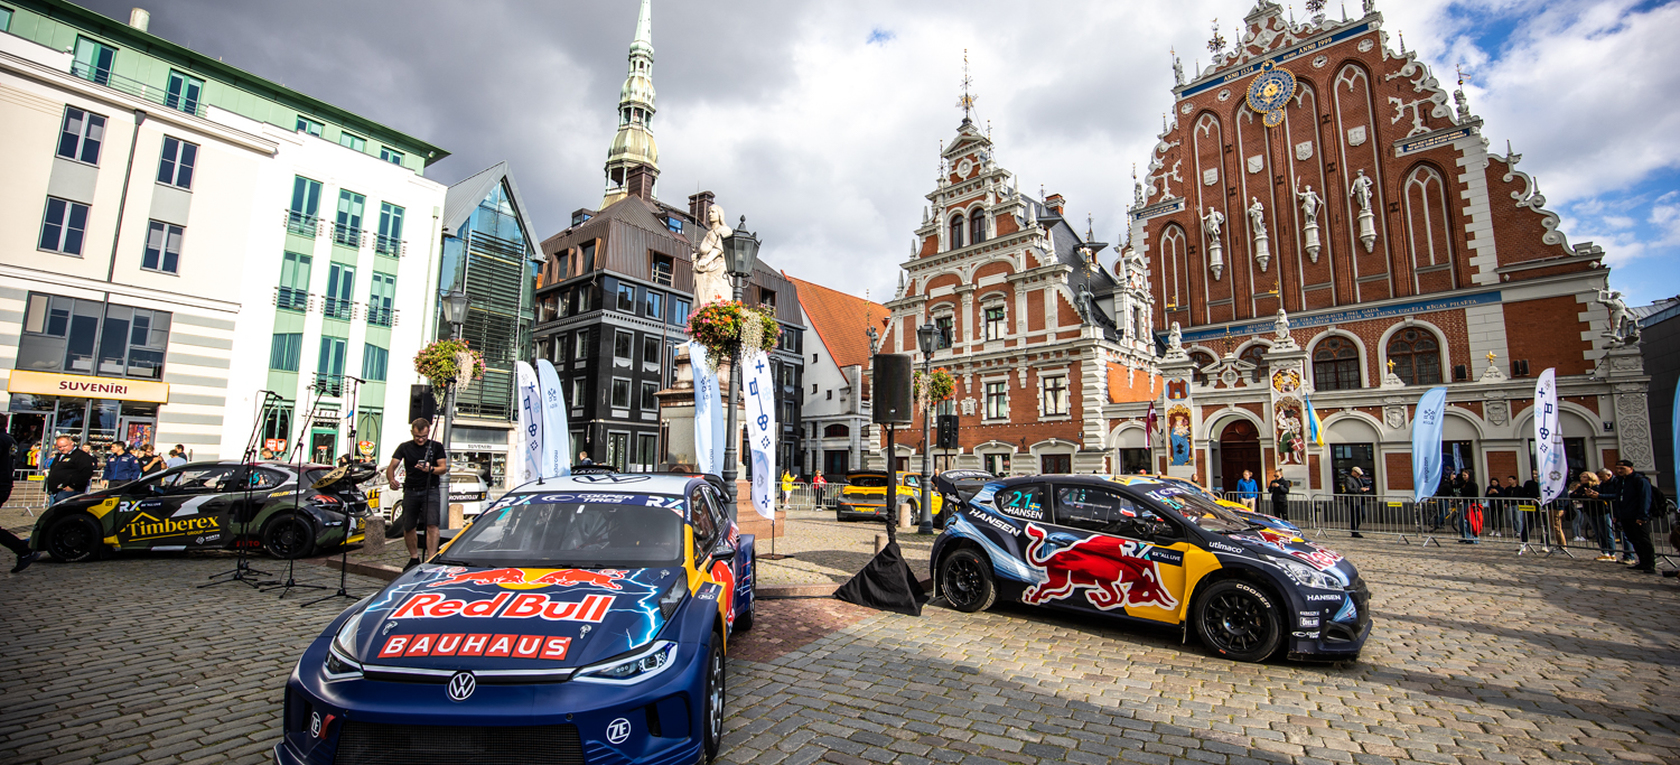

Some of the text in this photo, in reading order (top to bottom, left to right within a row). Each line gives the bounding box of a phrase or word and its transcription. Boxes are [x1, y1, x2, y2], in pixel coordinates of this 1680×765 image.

[59, 380, 128, 394] SUVENĪRI
[1009, 491, 1033, 509] 21
[969, 507, 1022, 537] HANSEN
[1007, 506, 1044, 520] HANSEN
[126, 516, 220, 537] Timberex
[1119, 540, 1155, 560] RX
[1209, 542, 1242, 554] utimaco
[1236, 583, 1272, 609] COOPER
[388, 592, 617, 622] Red Bull
[383, 636, 568, 655] BAUHAUS
[608, 720, 631, 742] ZF
